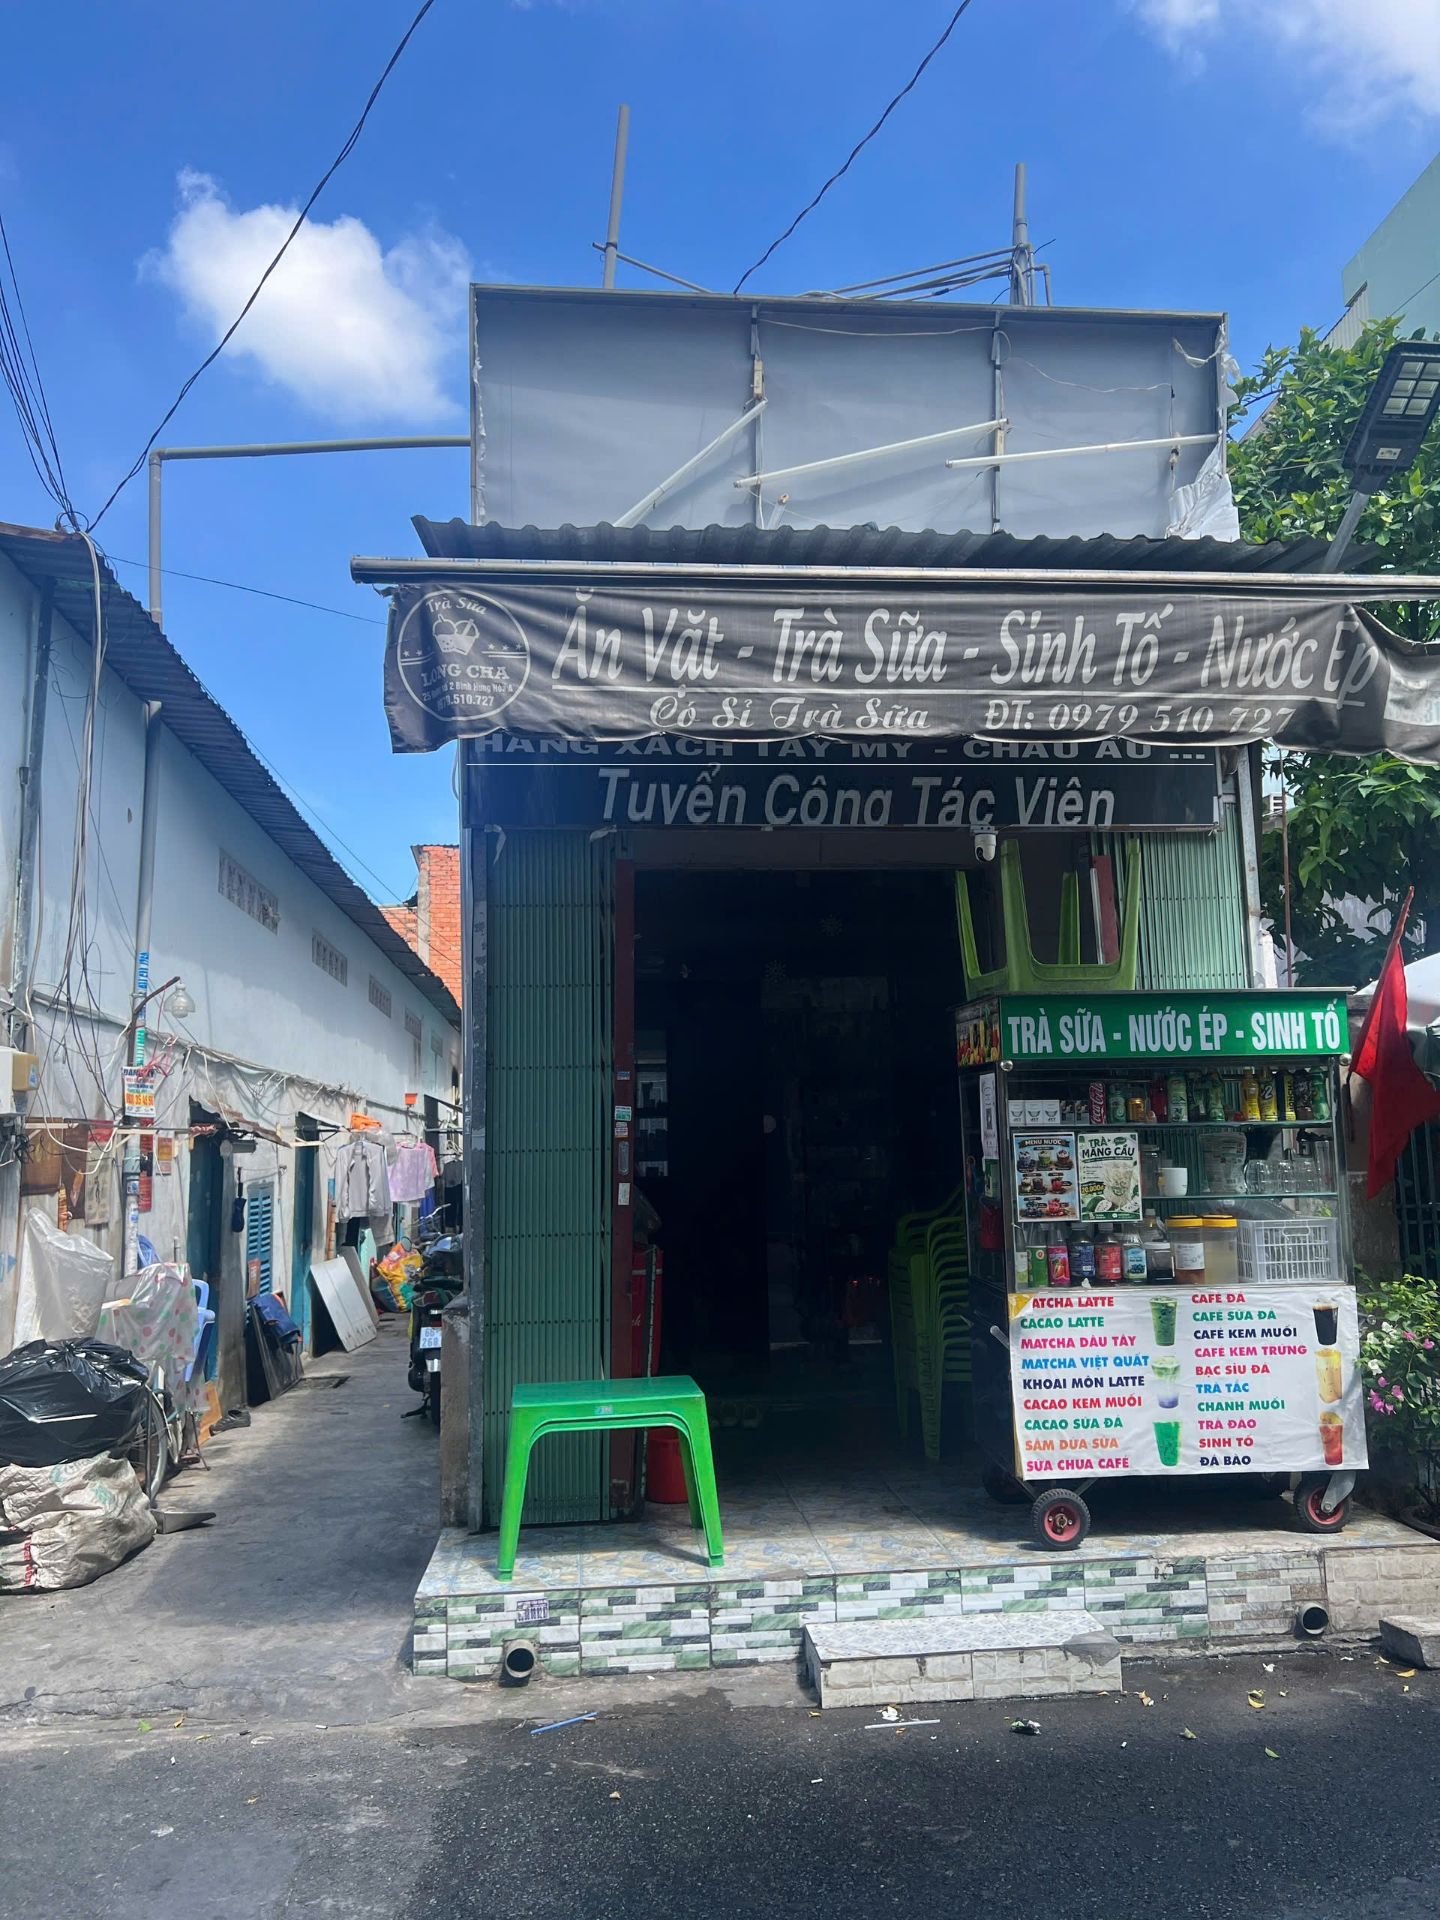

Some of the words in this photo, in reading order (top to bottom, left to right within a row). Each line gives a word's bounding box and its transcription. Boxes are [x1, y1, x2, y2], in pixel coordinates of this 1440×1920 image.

[426, 597, 451, 613] Trà
[456, 597, 488, 615] Sữa
[642, 608, 724, 698] Vặt
[772, 608, 843, 683] Trà
[854, 608, 947, 683] Sữa
[990, 609, 1097, 685] Sinh
[1112, 603, 1174, 686] Tố
[1201, 614, 1318, 689] Nước
[421, 663, 462, 687] LONG
[466, 664, 510, 680] CHA
[650, 695, 700, 728] Có
[712, 697, 754, 728] Sỉ
[769, 697, 846, 729] Trà
[856, 697, 931, 729] Sữa
[984, 700, 1035, 730] ĐT:
[1048, 703, 1139, 733] 0979
[1150, 705, 1214, 734] 510
[1229, 707, 1296, 735] 727
[598, 762, 747, 825] Tuyển
[764, 774, 893, 826] Công
[911, 776, 996, 826] Tác
[1015, 776, 1115, 828] Viên
[1008, 1008, 1053, 1054] TRÀ
[1059, 1007, 1107, 1054] SỮA
[1128, 1006, 1192, 1052] NƯỚC
[1198, 1006, 1228, 1051] ÉP
[1251, 1012, 1307, 1050] SINH
[1311, 999, 1341, 1050] TỐ
[1032, 1297, 1073, 1309] ATCHA
[1078, 1296, 1114, 1307] LATTE
[1020, 1317, 1063, 1329] CACAO
[1068, 1316, 1104, 1328] LATTE
[1228, 1328, 1257, 1339] KEM
[1021, 1337, 1075, 1349] MATCHA
[1229, 1346, 1257, 1357] KEM
[1022, 1358, 1077, 1370] MATCHA
[1080, 1354, 1108, 1370] VIỆT
[1195, 1365, 1221, 1378] BẠC
[1023, 1378, 1067, 1390] KHOAI
[1071, 1375, 1104, 1388] MÔN
[1109, 1376, 1144, 1388] LATTE
[1024, 1398, 1067, 1410] CACAO
[1072, 1397, 1101, 1409] KEM
[1197, 1401, 1244, 1412] CHANH
[1024, 1418, 1068, 1430] CACAO
[1199, 1437, 1232, 1448] SINH
[1057, 1458, 1094, 1471] CHUA
